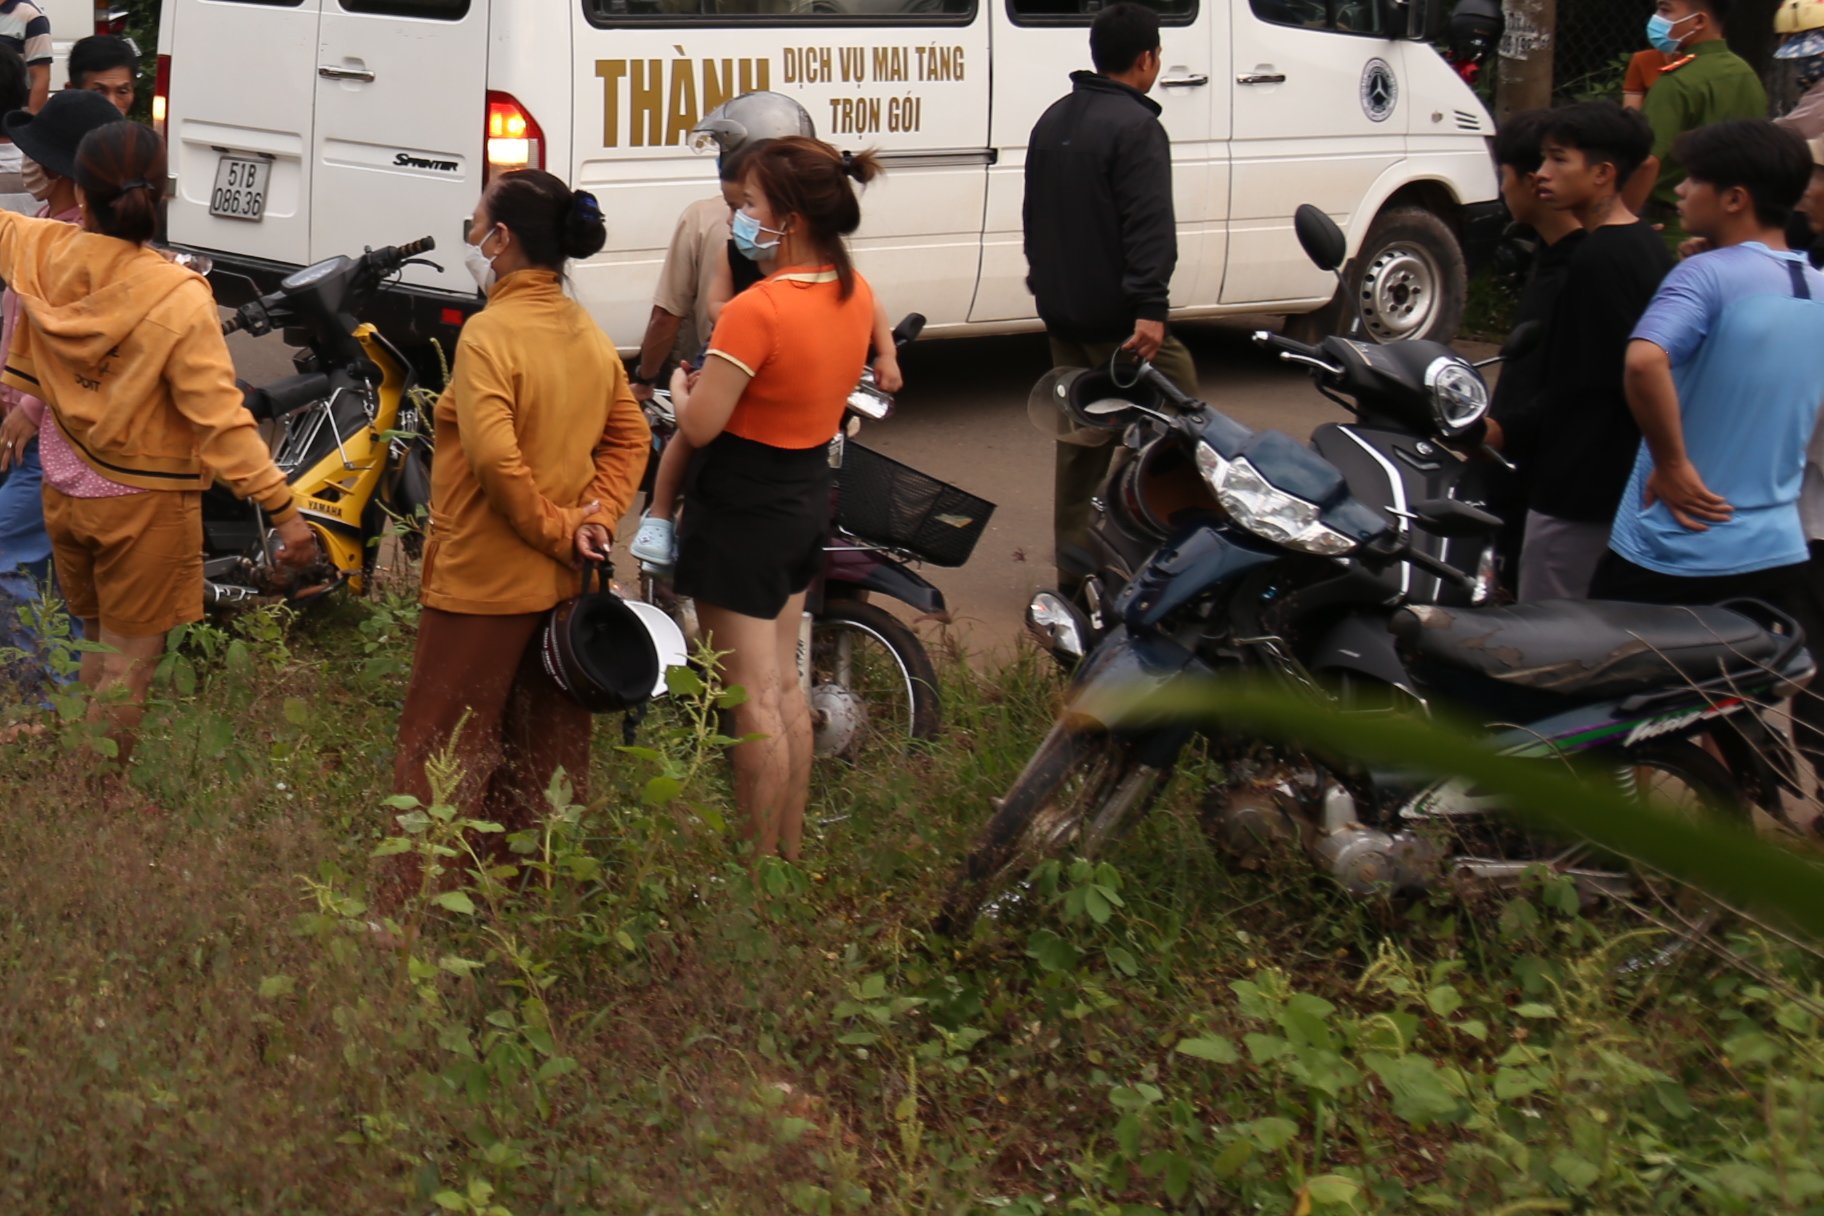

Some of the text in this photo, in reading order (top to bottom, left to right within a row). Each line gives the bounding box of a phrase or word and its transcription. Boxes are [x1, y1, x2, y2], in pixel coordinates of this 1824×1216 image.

[783, 46, 832, 89] DỊCH
[838, 47, 866, 89] VỤ
[873, 46, 909, 82] MAI
[915, 41, 965, 82] TÁNG
[829, 91, 921, 140] TRỌN GÓI
[228, 162, 257, 188] 51B
[213, 188, 262, 216] 086.36
[307, 500, 343, 518] YAMAHA
